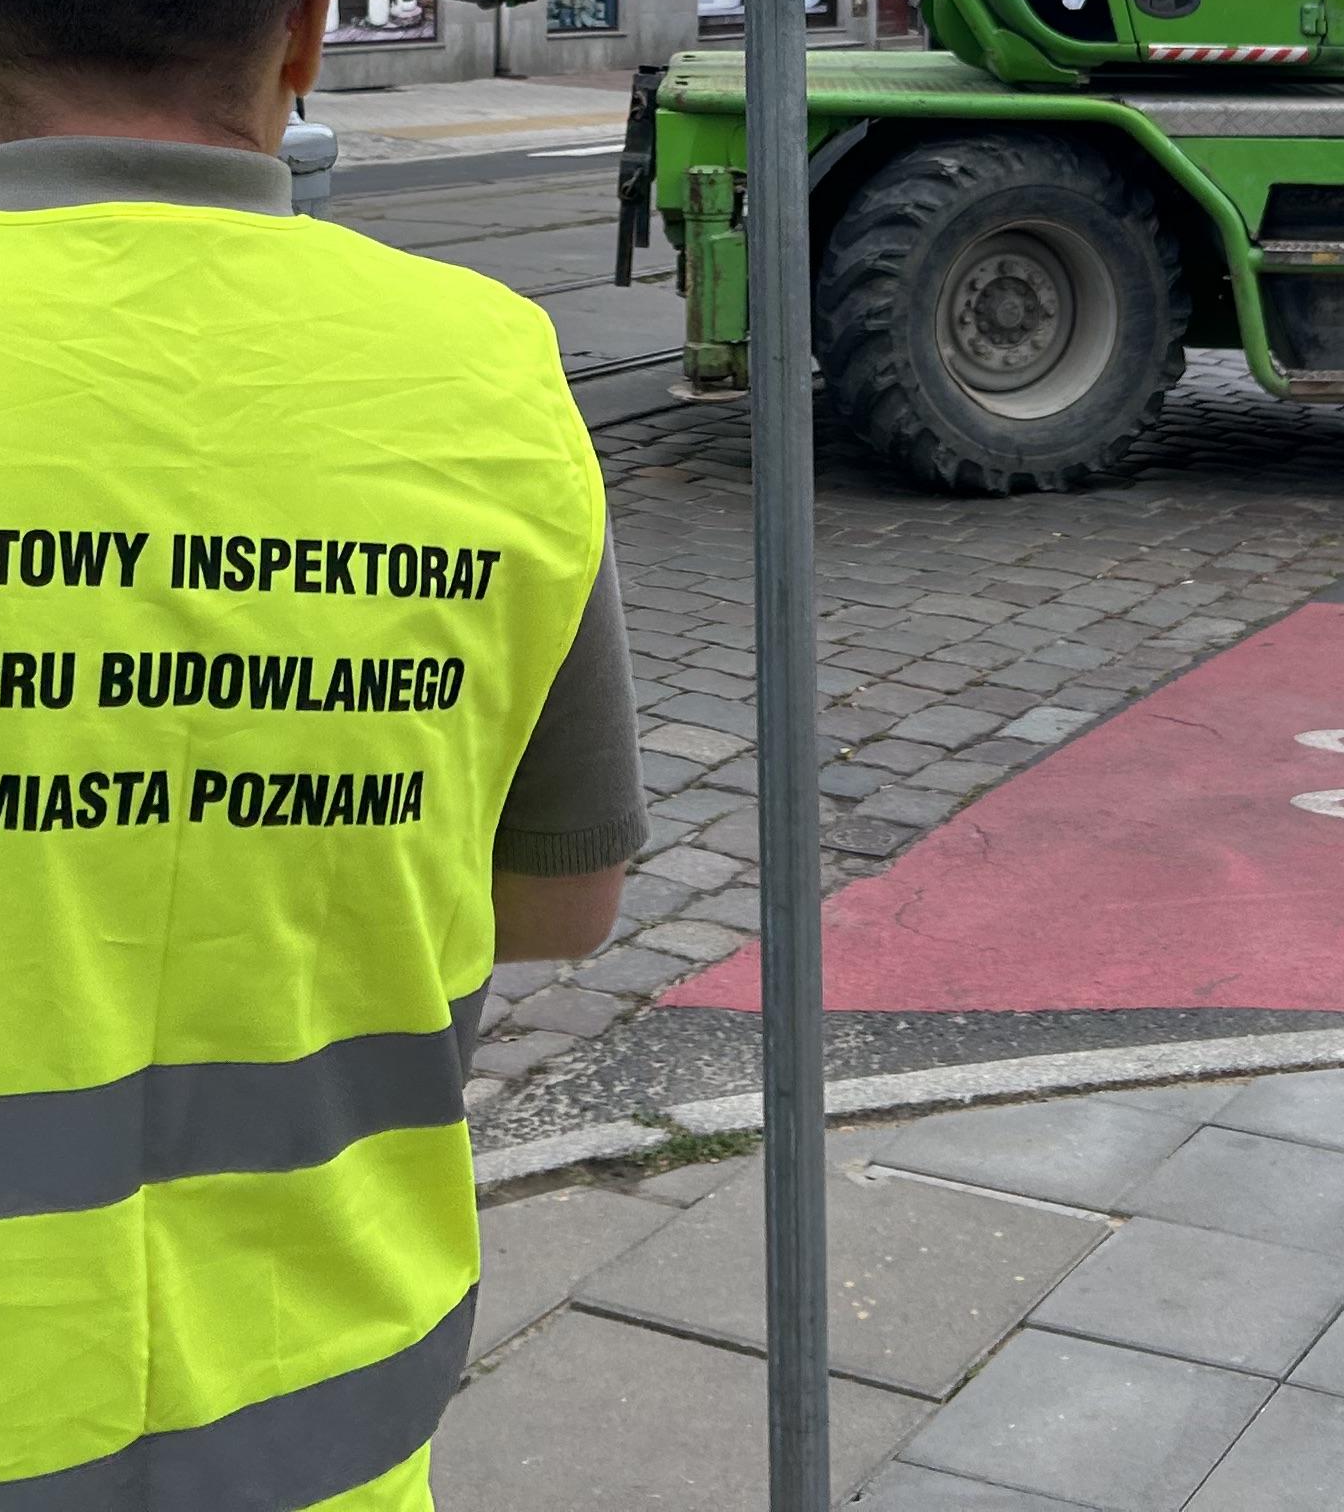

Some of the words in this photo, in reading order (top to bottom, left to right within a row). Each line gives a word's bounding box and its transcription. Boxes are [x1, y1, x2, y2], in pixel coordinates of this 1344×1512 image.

[170, 533, 501, 601] INSPEKTORAT
[98, 651, 465, 713] BUDOWLANEGO
[189, 769, 424, 827] POZNANIA
